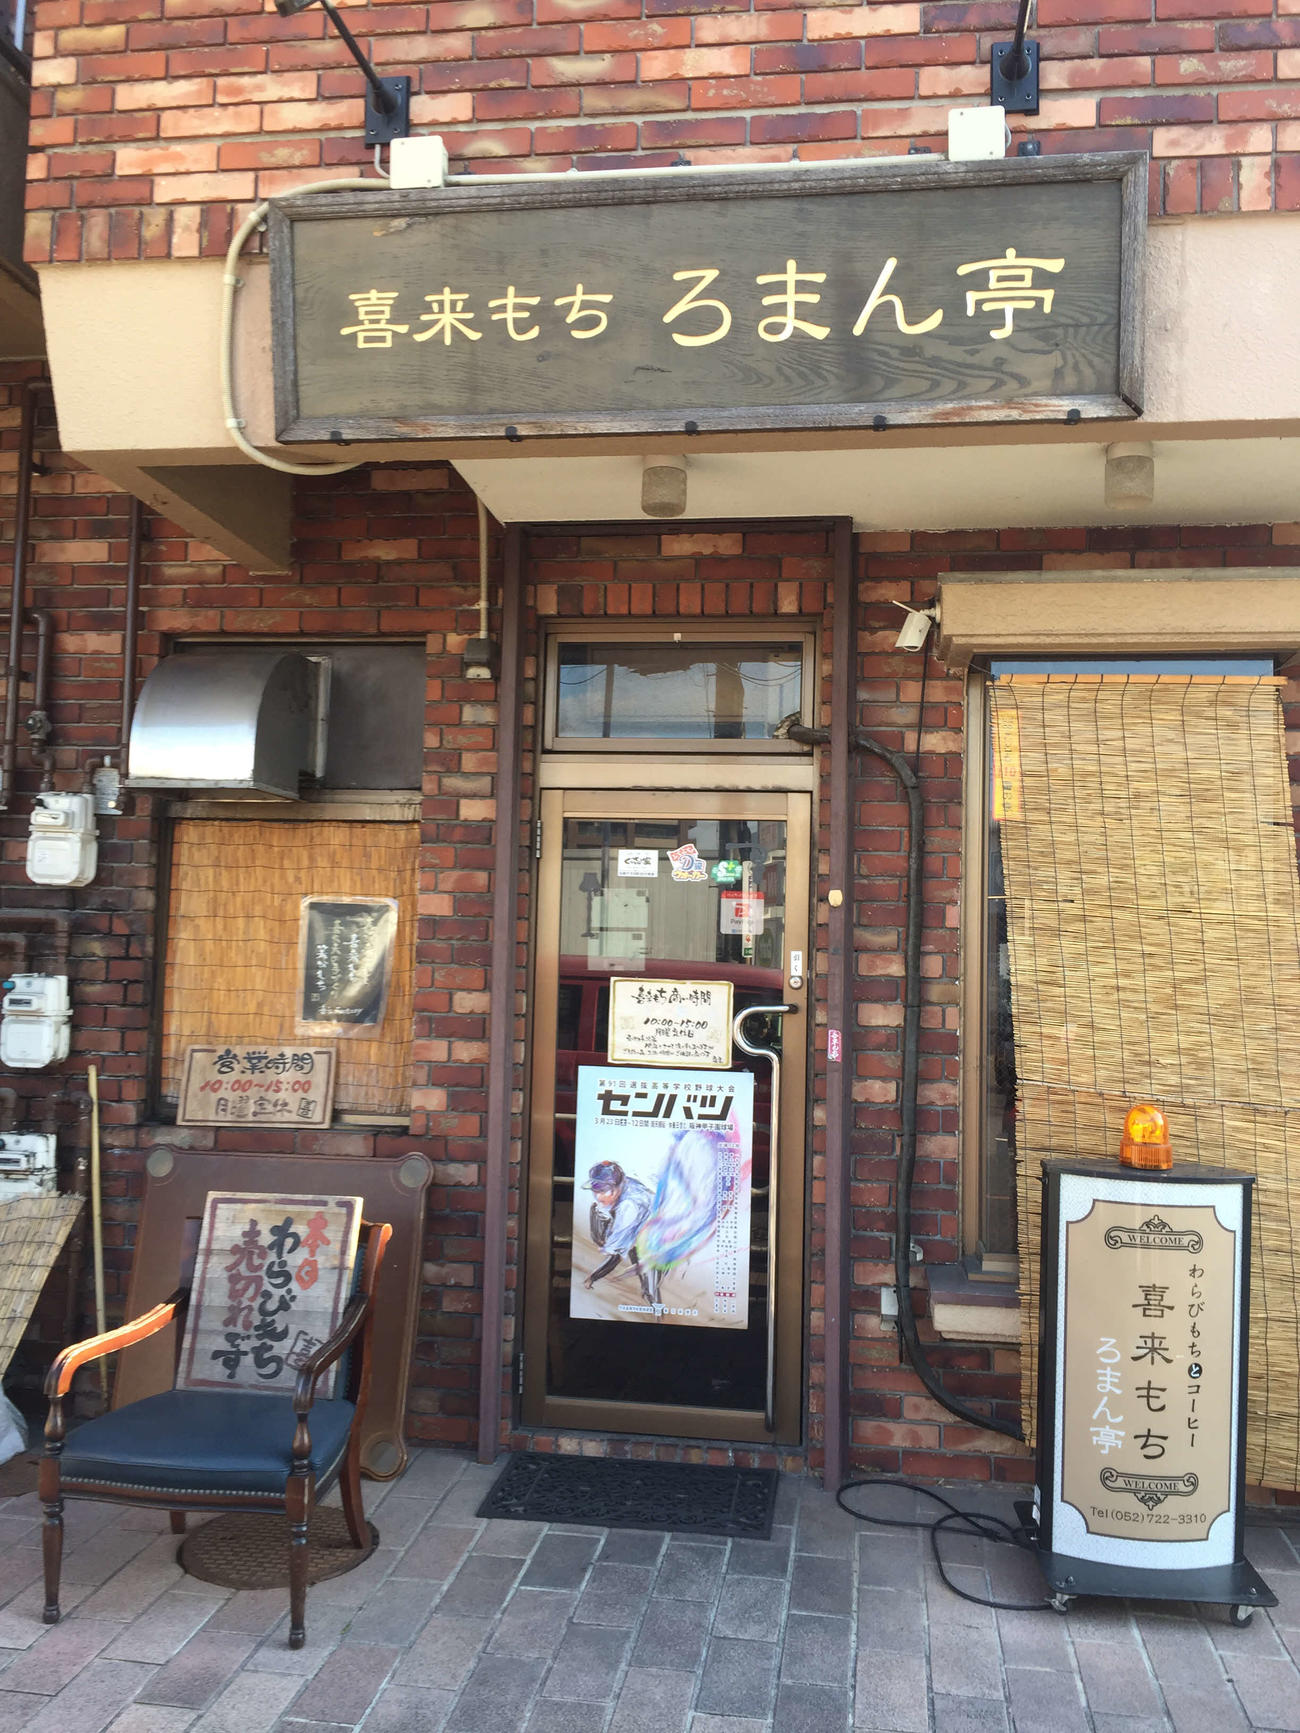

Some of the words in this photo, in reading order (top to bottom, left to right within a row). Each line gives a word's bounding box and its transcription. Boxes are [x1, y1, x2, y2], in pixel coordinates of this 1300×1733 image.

[340, 283, 613, 349] 喜来もち
[661, 247, 1066, 348] ろまん亭
[212, 1049, 314, 1075] 営業時間
[597, 1089, 734, 1121] センバツ
[295, 1211, 331, 1291] 本日
[1127, 1233, 1185, 1247] WELCOME
[210, 1218, 268, 1380] 売切れです
[251, 1216, 301, 1380] わらびもち
[1090, 1337, 1125, 1454] ろまん亭
[1130, 1283, 1175, 1460] 喜来もち
[1186, 1264, 1204, 1448] わらびもちとコーヒー
[1123, 1479, 1180, 1492] WELCOME
